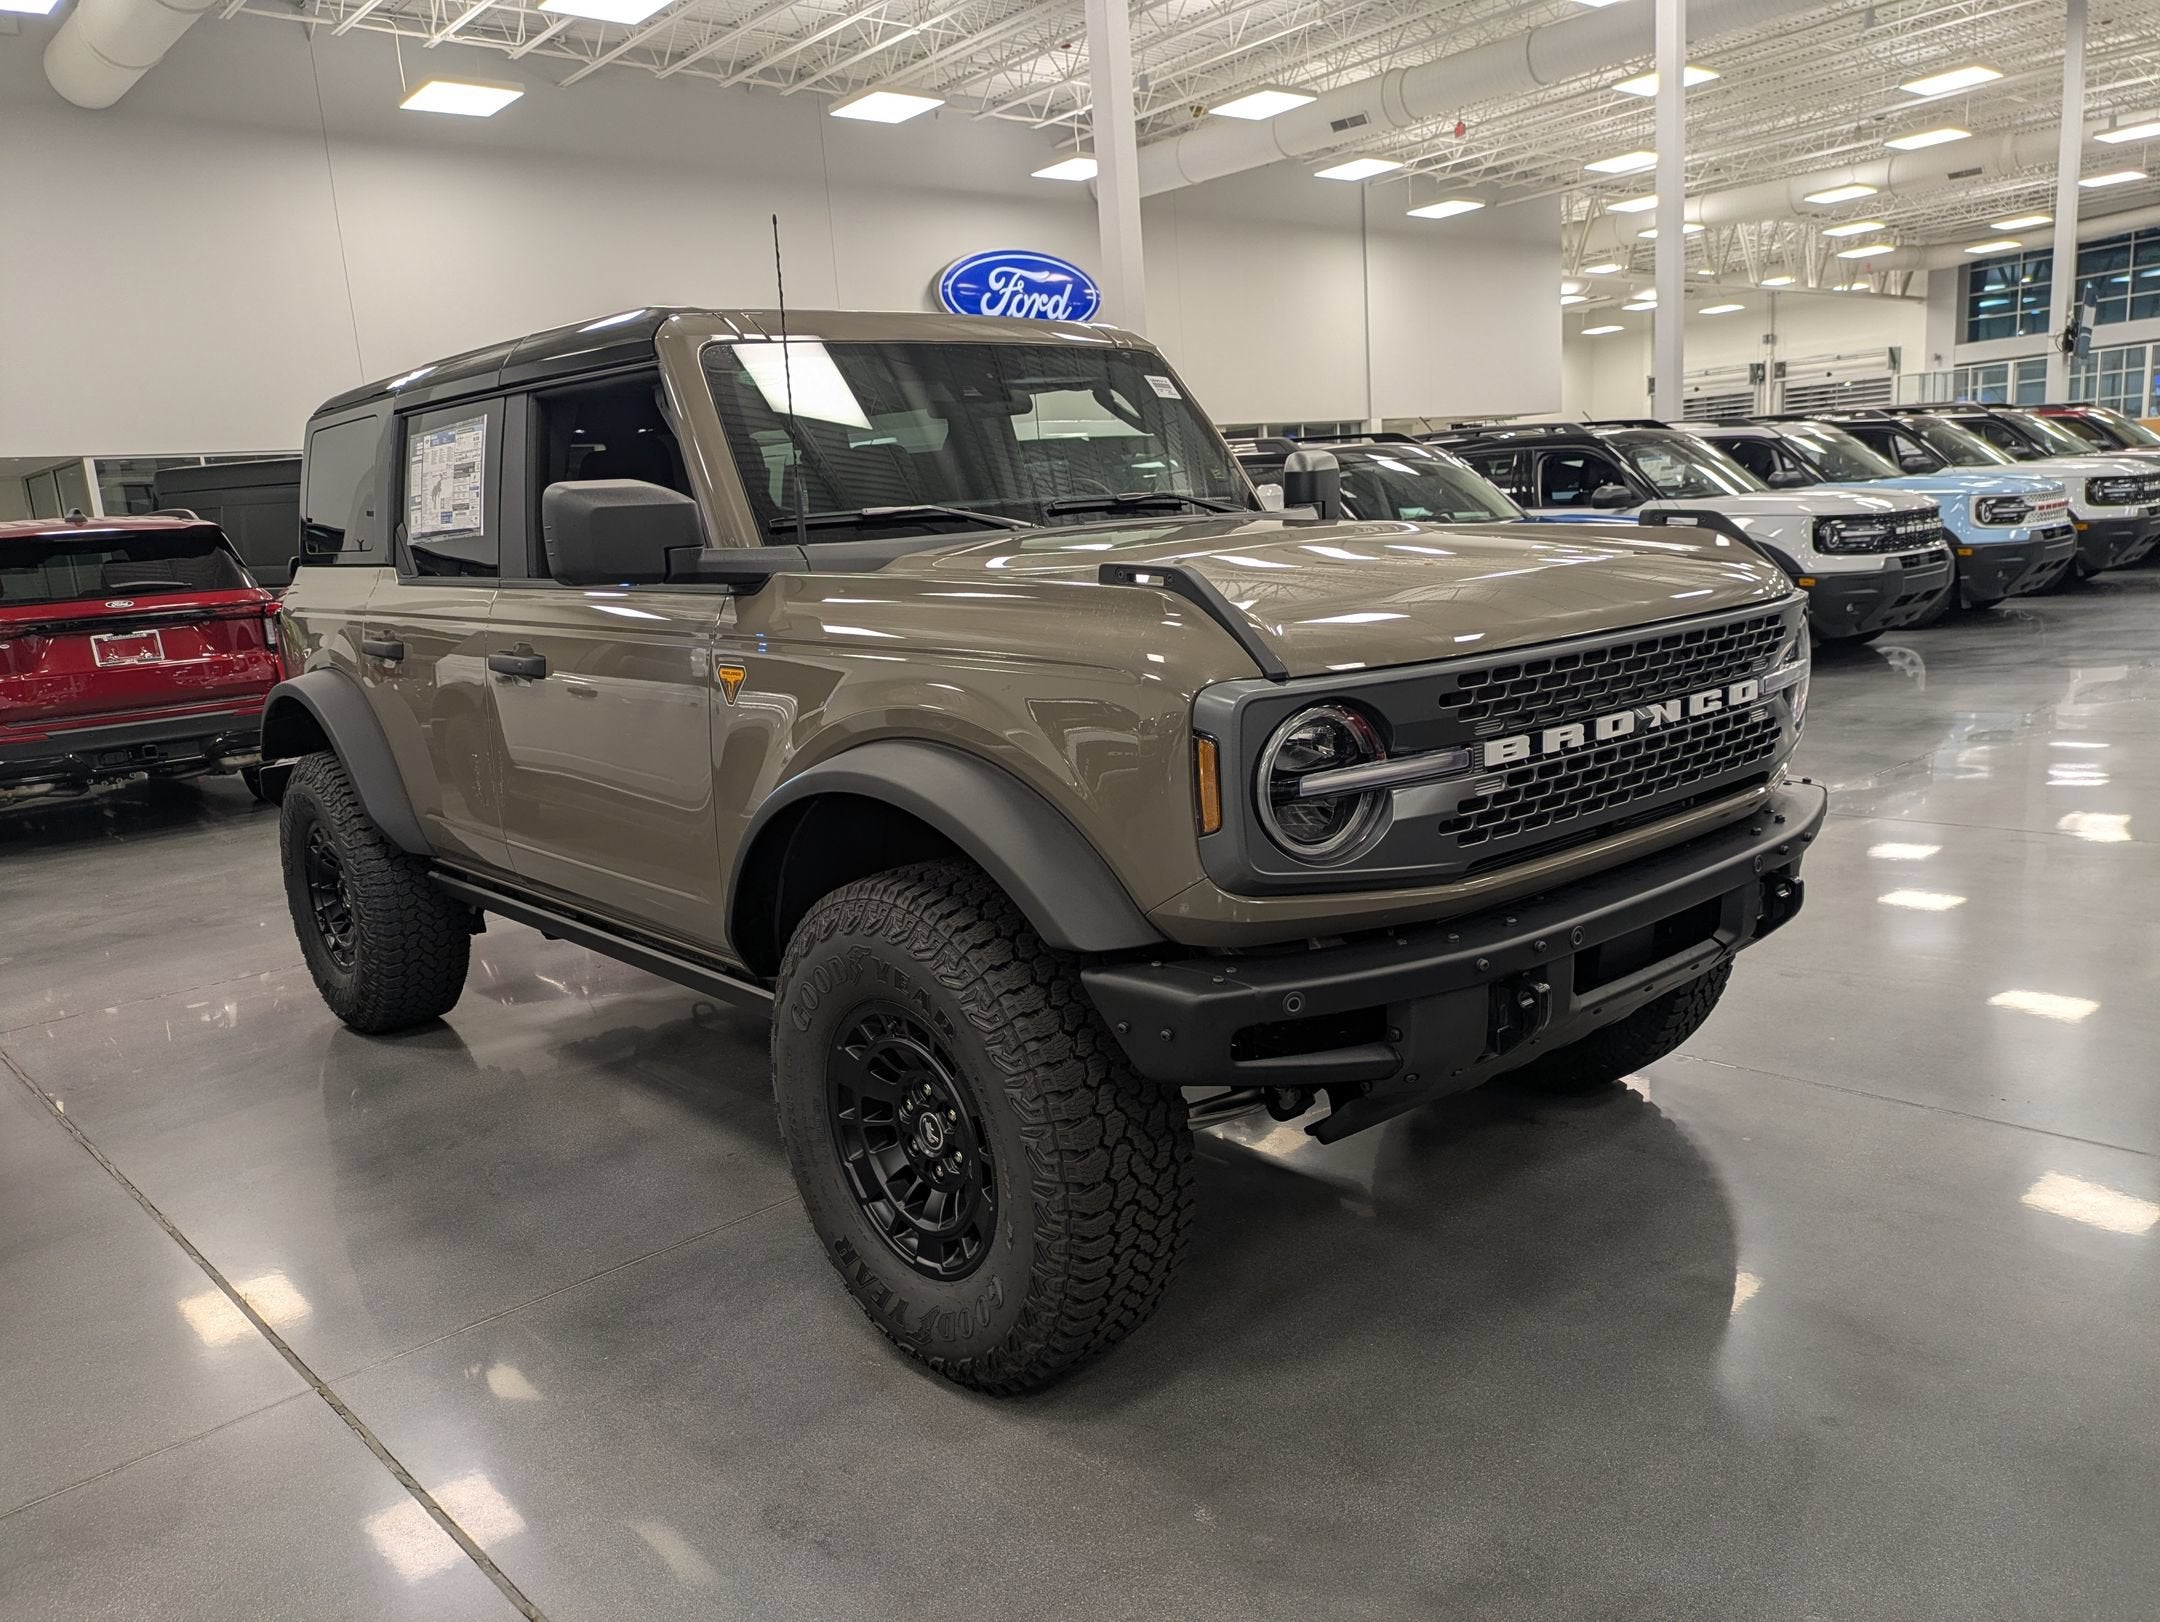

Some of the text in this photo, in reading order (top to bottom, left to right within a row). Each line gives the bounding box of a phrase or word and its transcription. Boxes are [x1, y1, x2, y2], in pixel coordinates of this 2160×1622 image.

[980, 266, 1073, 319] Ford
[1484, 679, 1759, 767] BRONCO
[791, 944, 956, 1039] GOODYEAR
